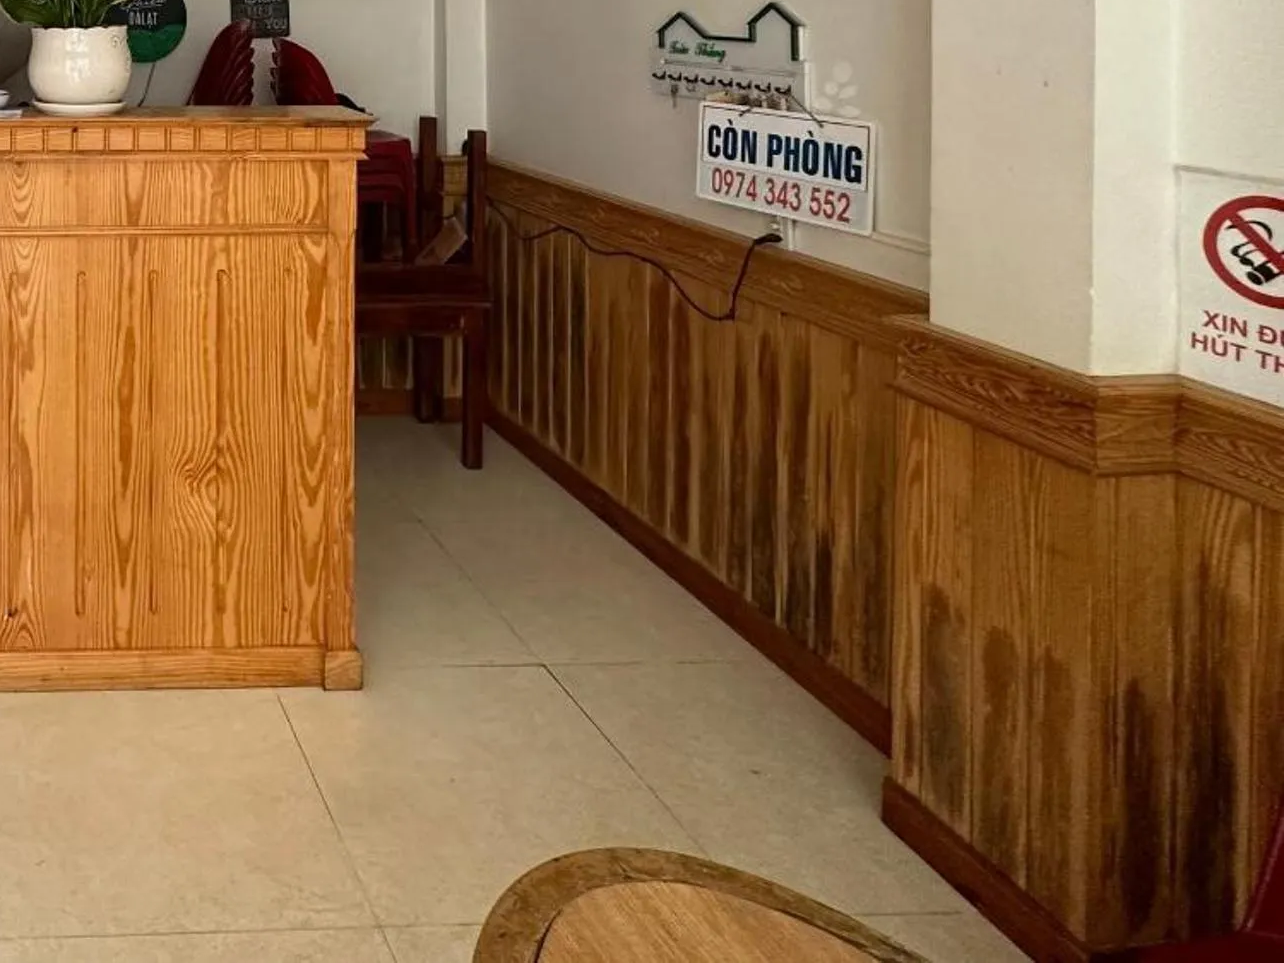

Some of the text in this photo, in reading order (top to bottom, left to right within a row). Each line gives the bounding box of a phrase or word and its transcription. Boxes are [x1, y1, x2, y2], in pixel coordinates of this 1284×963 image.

[707, 119, 862, 184] CÒN PHÒNG
[712, 168, 851, 223] 0974 343 552
[1202, 309, 1247, 338] XIN
[1191, 331, 1247, 362] HÚT
